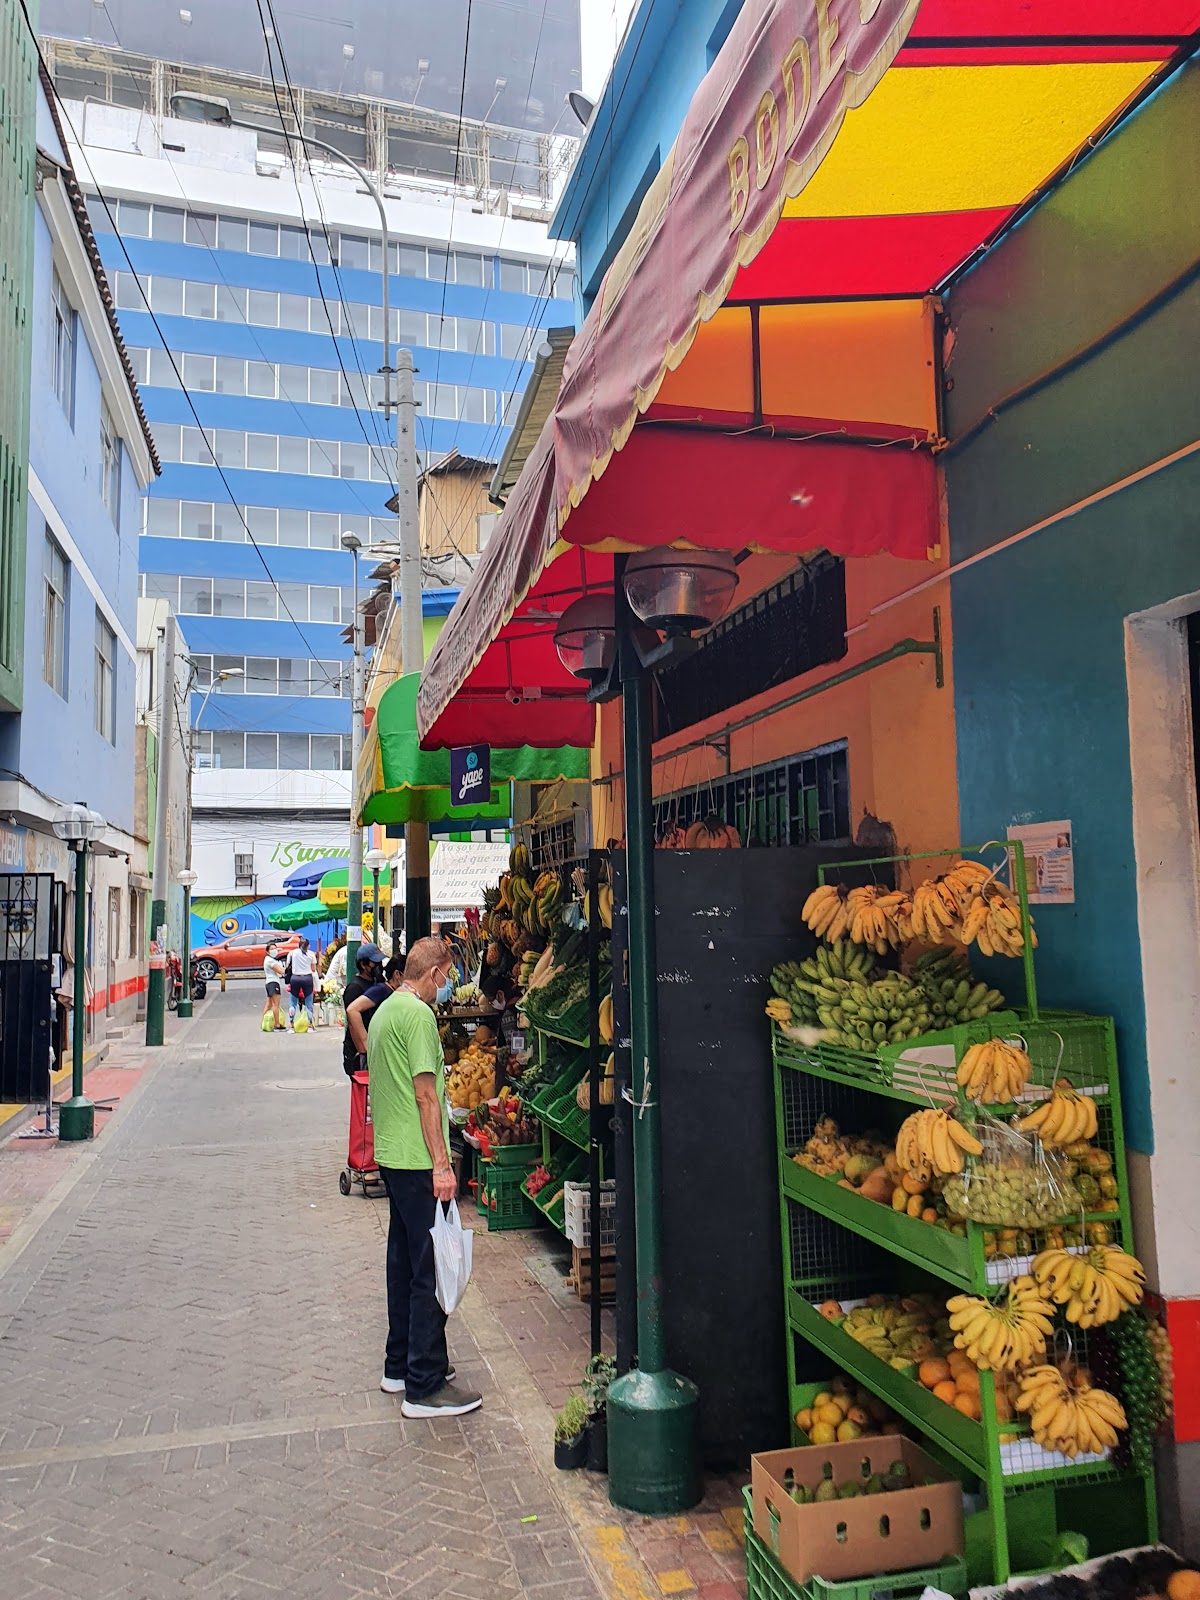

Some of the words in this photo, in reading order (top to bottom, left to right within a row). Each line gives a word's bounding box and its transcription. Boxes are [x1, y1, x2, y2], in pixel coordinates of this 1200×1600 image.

[728, 0, 883, 237] BODE
[459, 768, 484, 799] yape
[441, 842, 453, 852] Yo
[455, 843, 475, 854] soy
[470, 855, 490, 865] que
[337, 889, 376, 898] FLES
